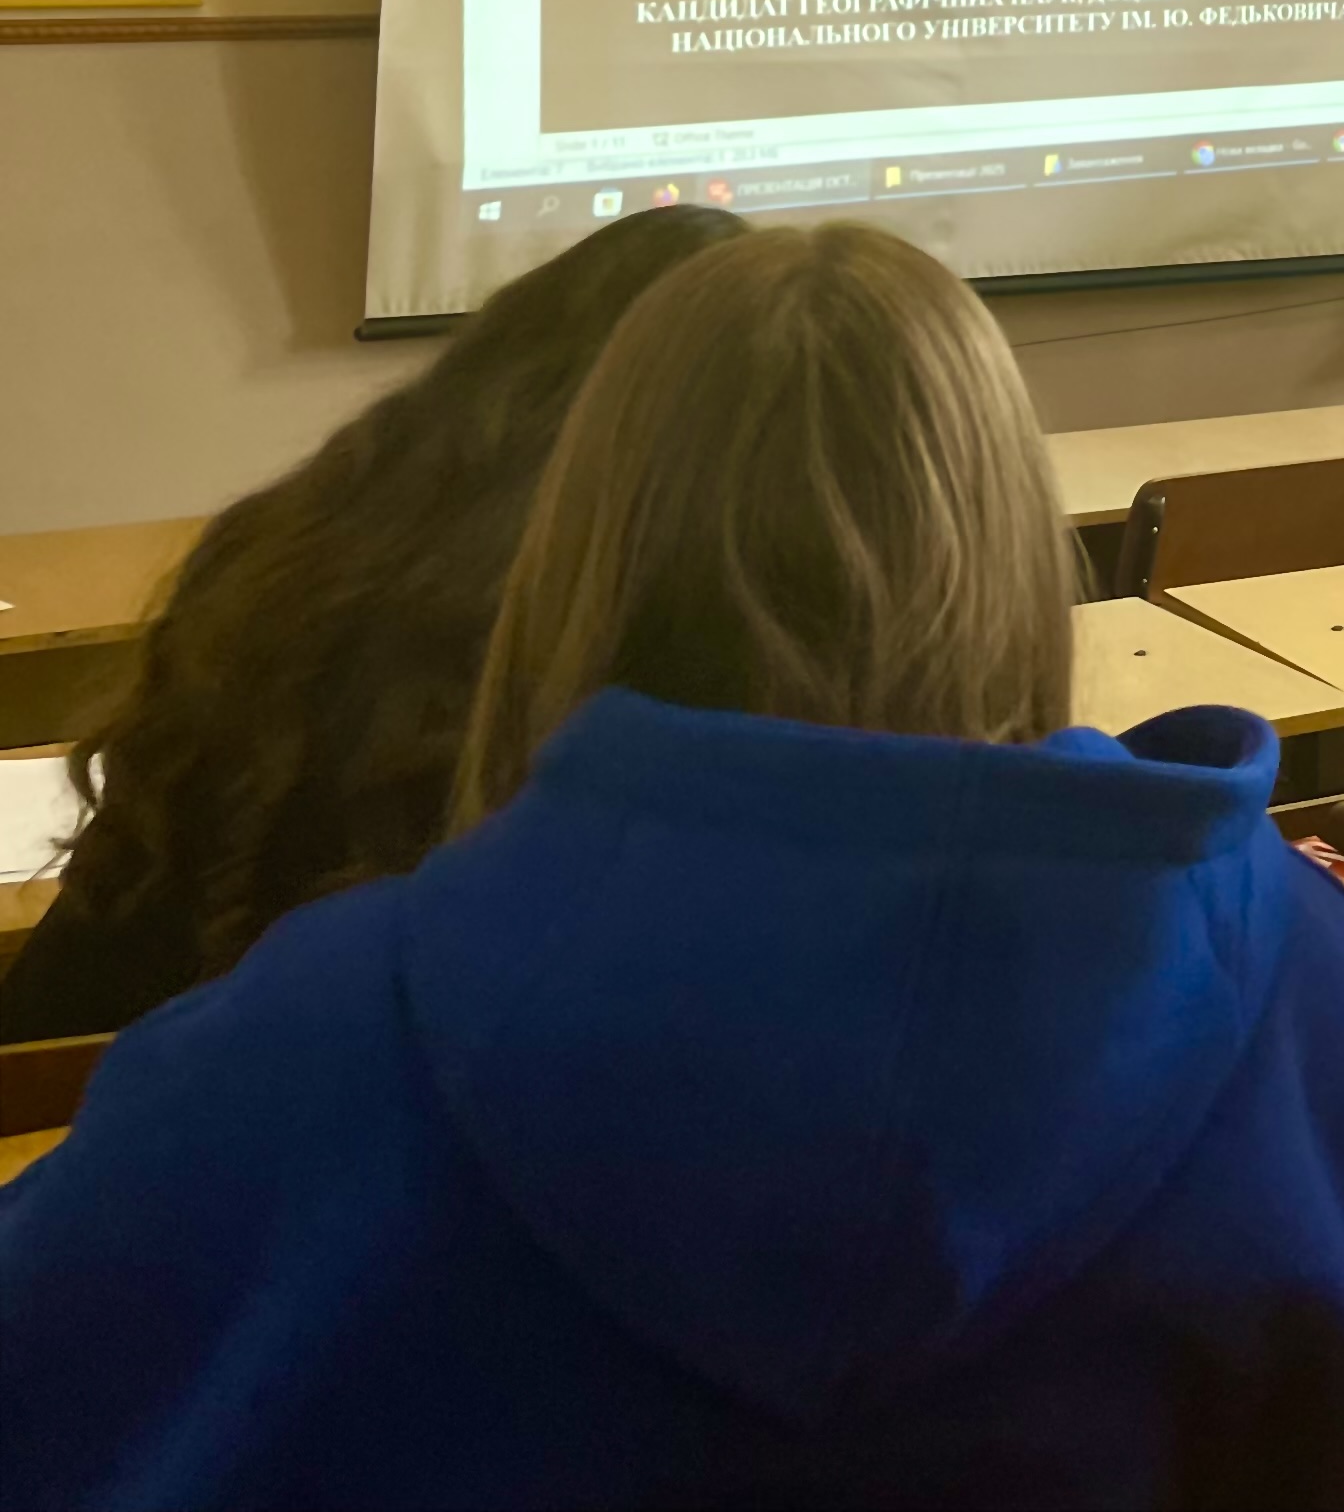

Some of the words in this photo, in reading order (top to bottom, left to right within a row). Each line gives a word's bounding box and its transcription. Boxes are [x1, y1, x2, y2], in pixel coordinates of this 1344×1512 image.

[672, 21, 915, 53] НАЦІОНАЛЬНОГО
[923, 11, 1116, 39] УНІВЕРСИТЕТУ
[1122, 10, 1156, 30] ІМ.
[1163, 8, 1193, 27] Ю.
